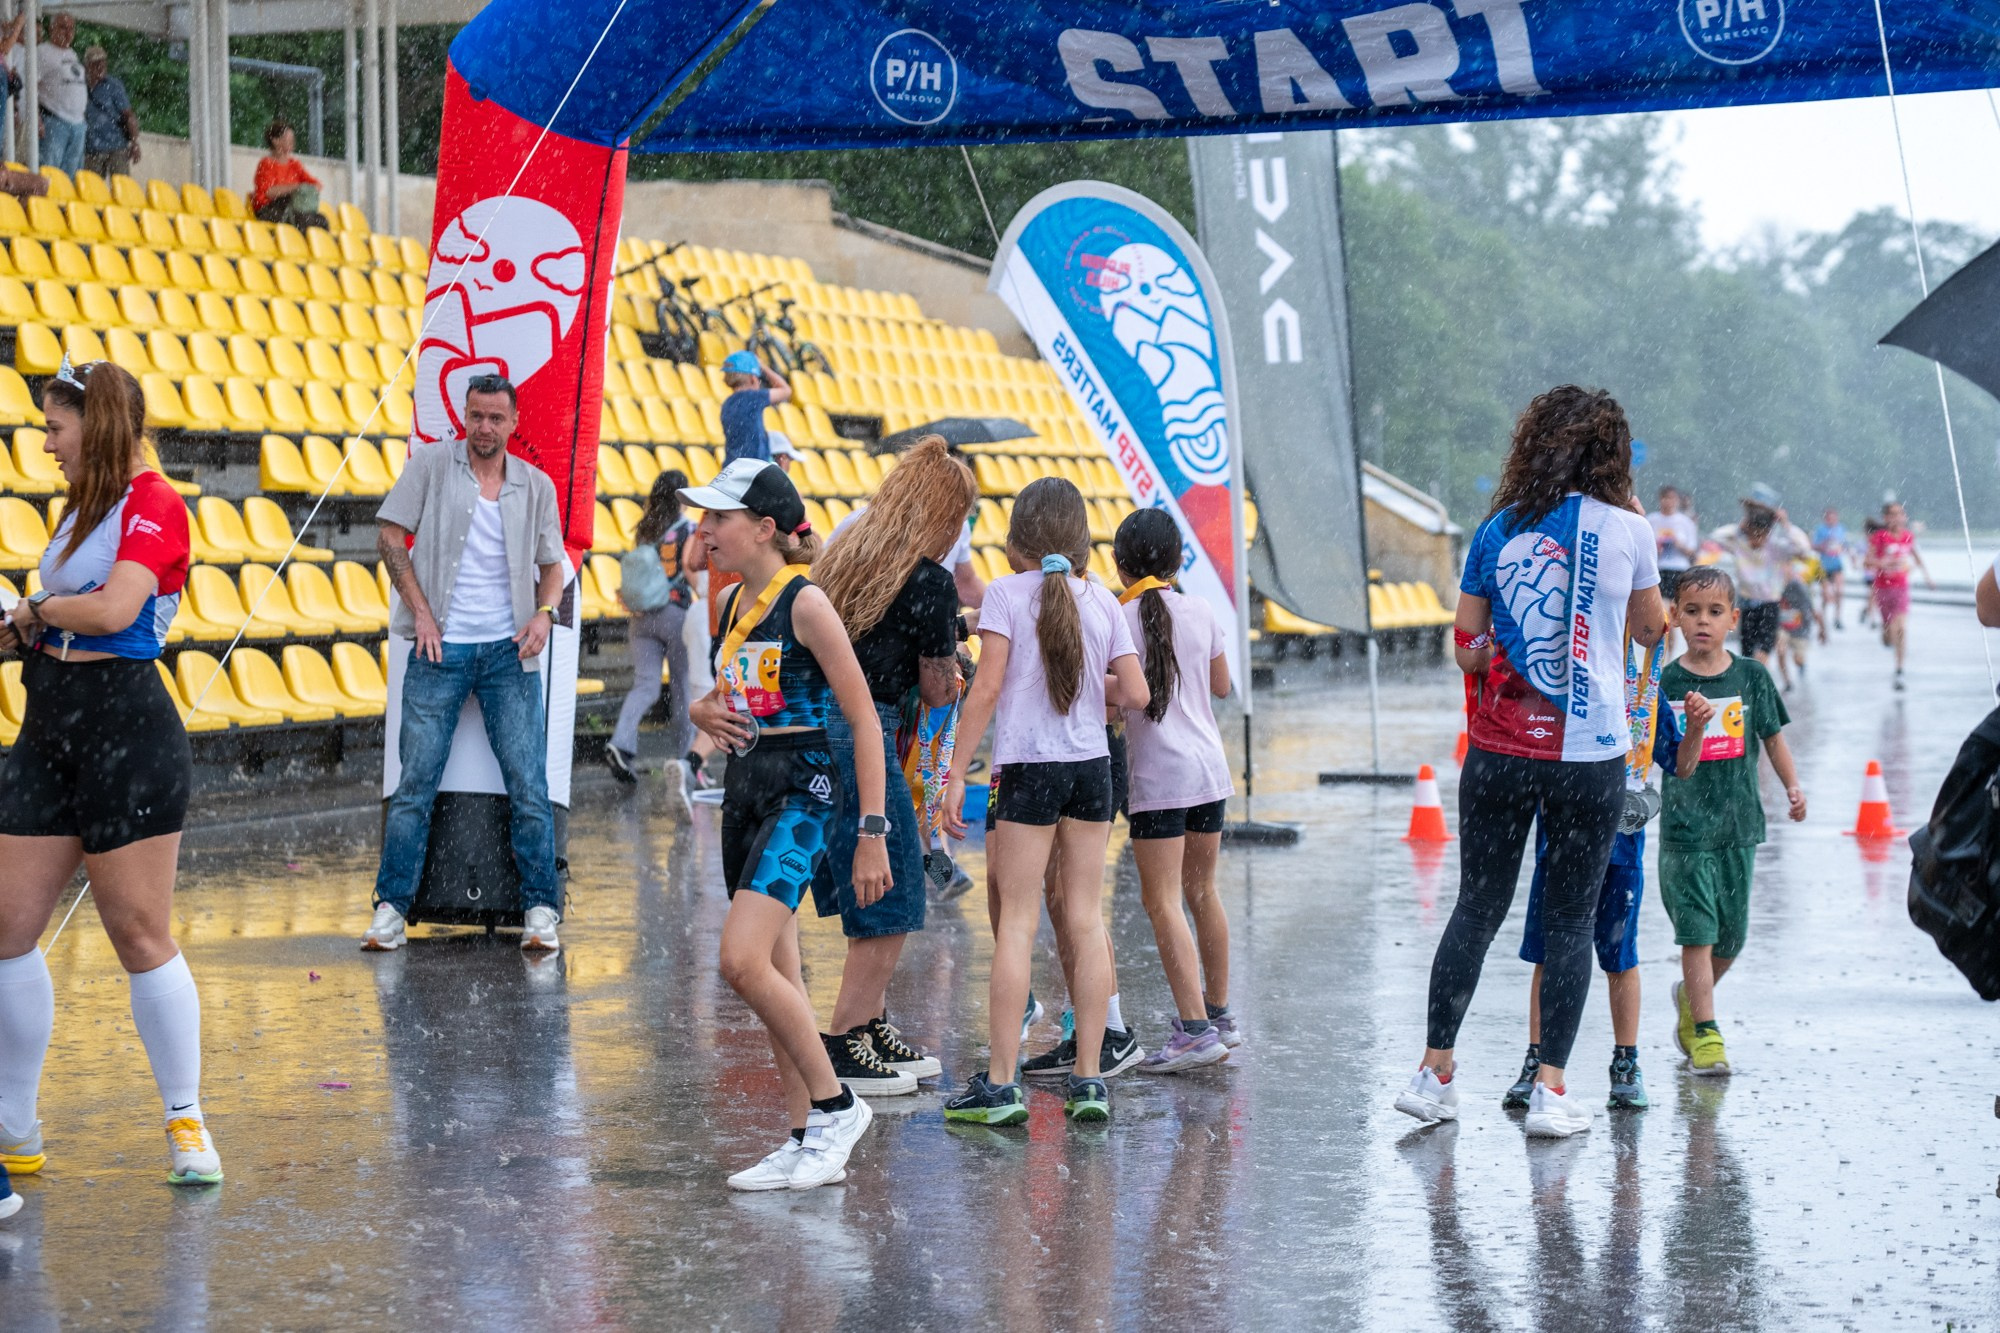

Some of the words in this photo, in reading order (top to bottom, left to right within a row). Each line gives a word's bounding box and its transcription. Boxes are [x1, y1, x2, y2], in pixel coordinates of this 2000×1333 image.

[1696, 0, 1766, 29] P/H
[1702, 26, 1770, 43] MARKOVO
[907, 48, 920, 56] IN
[1057, 0, 1551, 120] START
[886, 58, 942, 91] P/H
[886, 92, 942, 104] MARKOVO
[1576, 530, 1599, 615] MATTERS
[1572, 613, 1590, 662] STEP
[1571, 660, 1589, 719] EVERY
